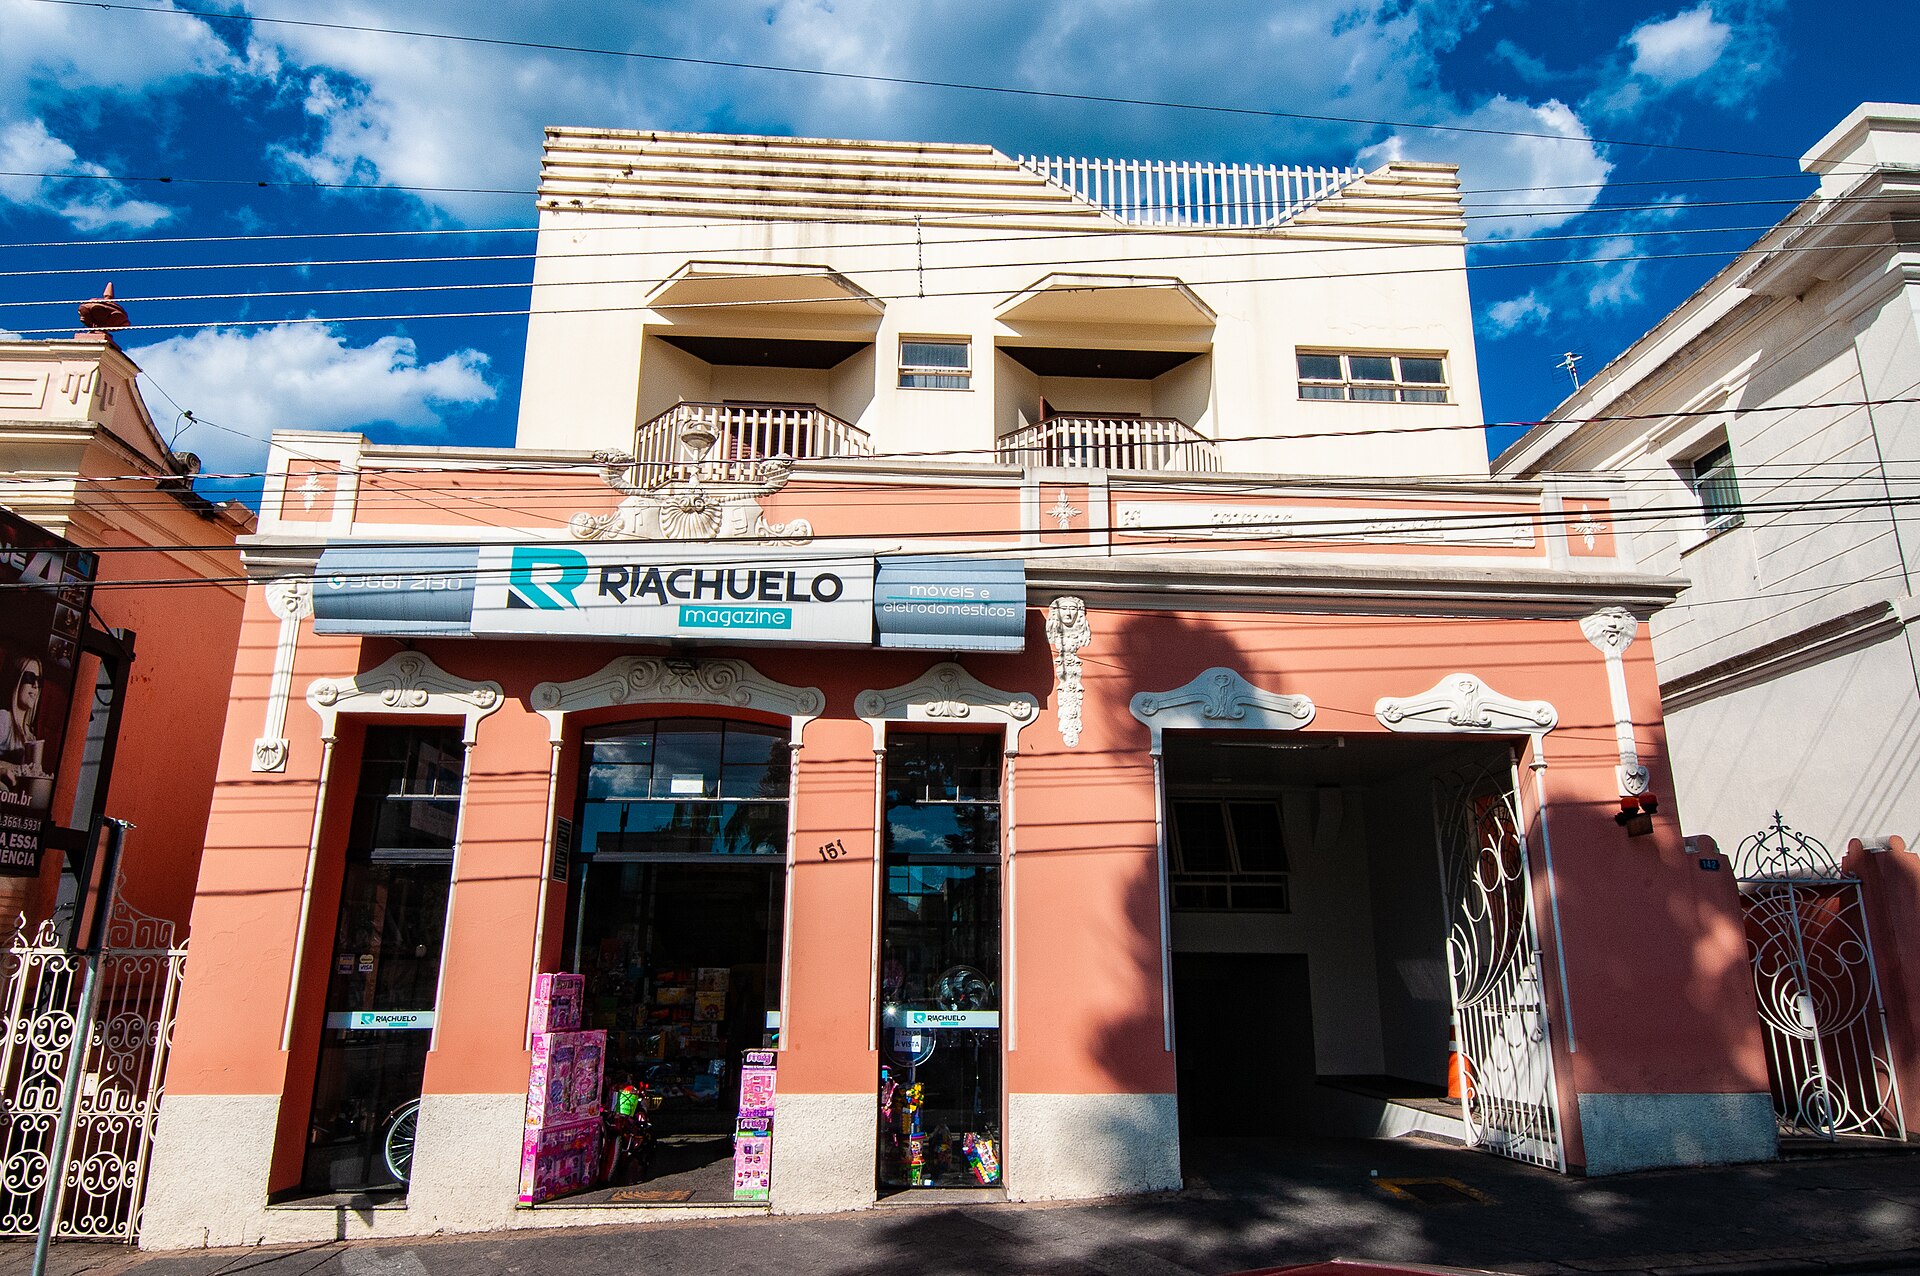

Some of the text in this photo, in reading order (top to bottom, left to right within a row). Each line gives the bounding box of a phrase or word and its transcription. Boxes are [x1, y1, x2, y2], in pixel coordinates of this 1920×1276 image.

[410, 575, 463, 591] 2130
[598, 565, 843, 605] RIACHUELO
[909, 584, 990, 599] móveis e
[685, 608, 786, 626] magazine
[883, 602, 1016, 617] eletrodomésticos
[0, 789, 33, 806] om.br
[9, 833, 38, 850] ESSA
[0, 845, 35, 867] ÊNCIA
[818, 839, 847, 862] 151
[375, 1015, 417, 1023] RIACHUELO
